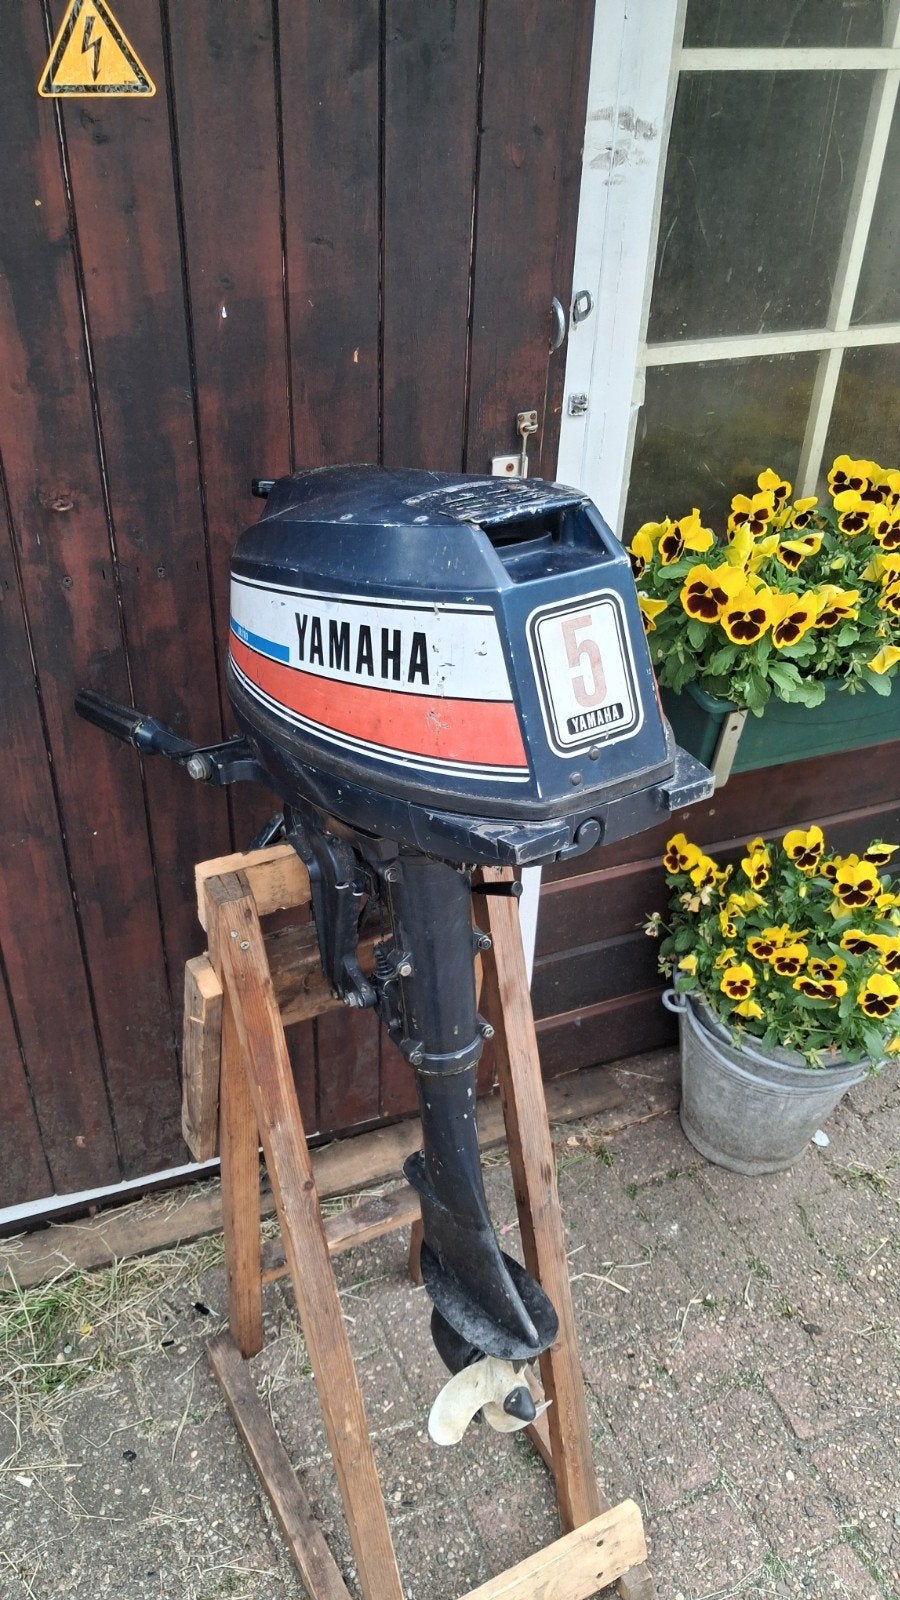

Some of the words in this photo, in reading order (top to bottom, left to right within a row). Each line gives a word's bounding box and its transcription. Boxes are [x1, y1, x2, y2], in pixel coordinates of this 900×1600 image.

[295, 612, 430, 686] YAMAHA
[561, 614, 608, 708] 5
[571, 706, 620, 733] YAMAHA
